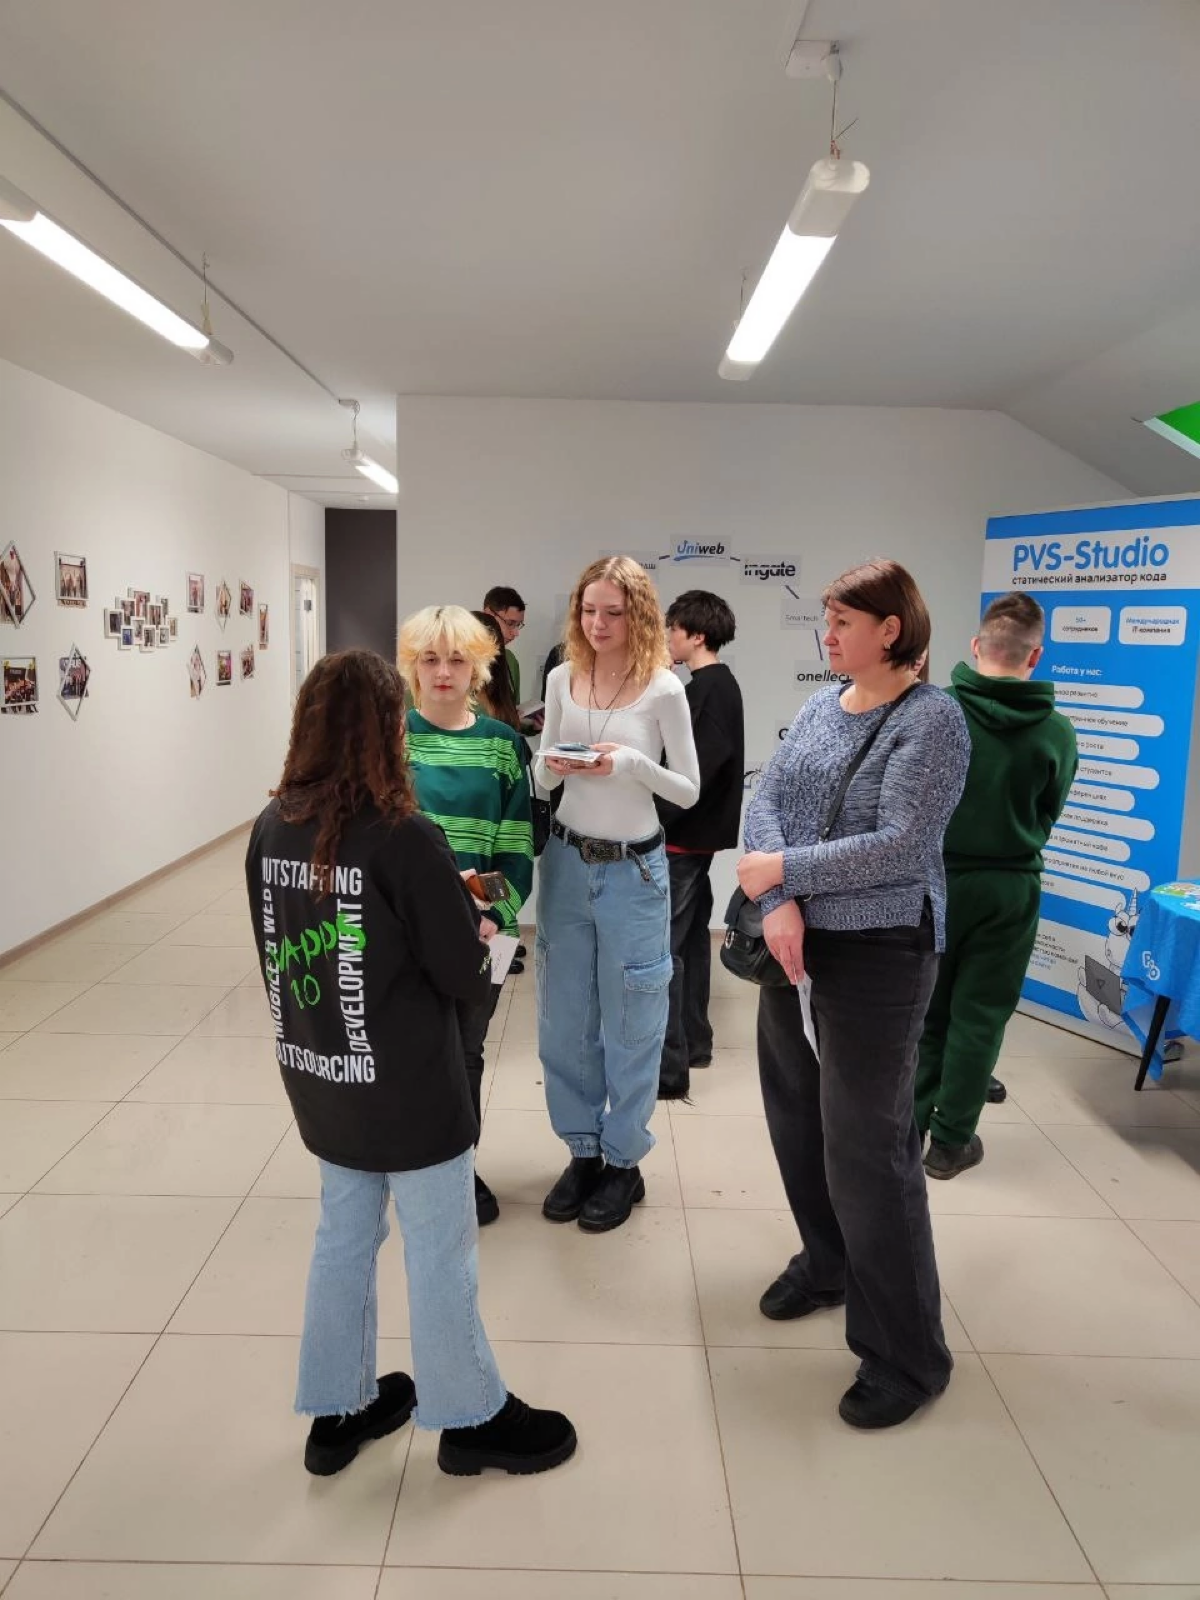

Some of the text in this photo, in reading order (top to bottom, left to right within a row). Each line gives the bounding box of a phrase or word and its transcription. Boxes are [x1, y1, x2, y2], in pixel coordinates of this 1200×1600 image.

[677, 540, 725, 555] Uniweb
[1013, 535, 1170, 572] PVS-Studio
[744, 561, 796, 580] ingate
[1012, 573, 1167, 585] статический анализатор кода
[1051, 664, 1078, 675] Работа
[1080, 668, 1085, 676] у
[337, 898, 373, 1053] DEVELOPMENT
[290, 974, 321, 1010] 10
